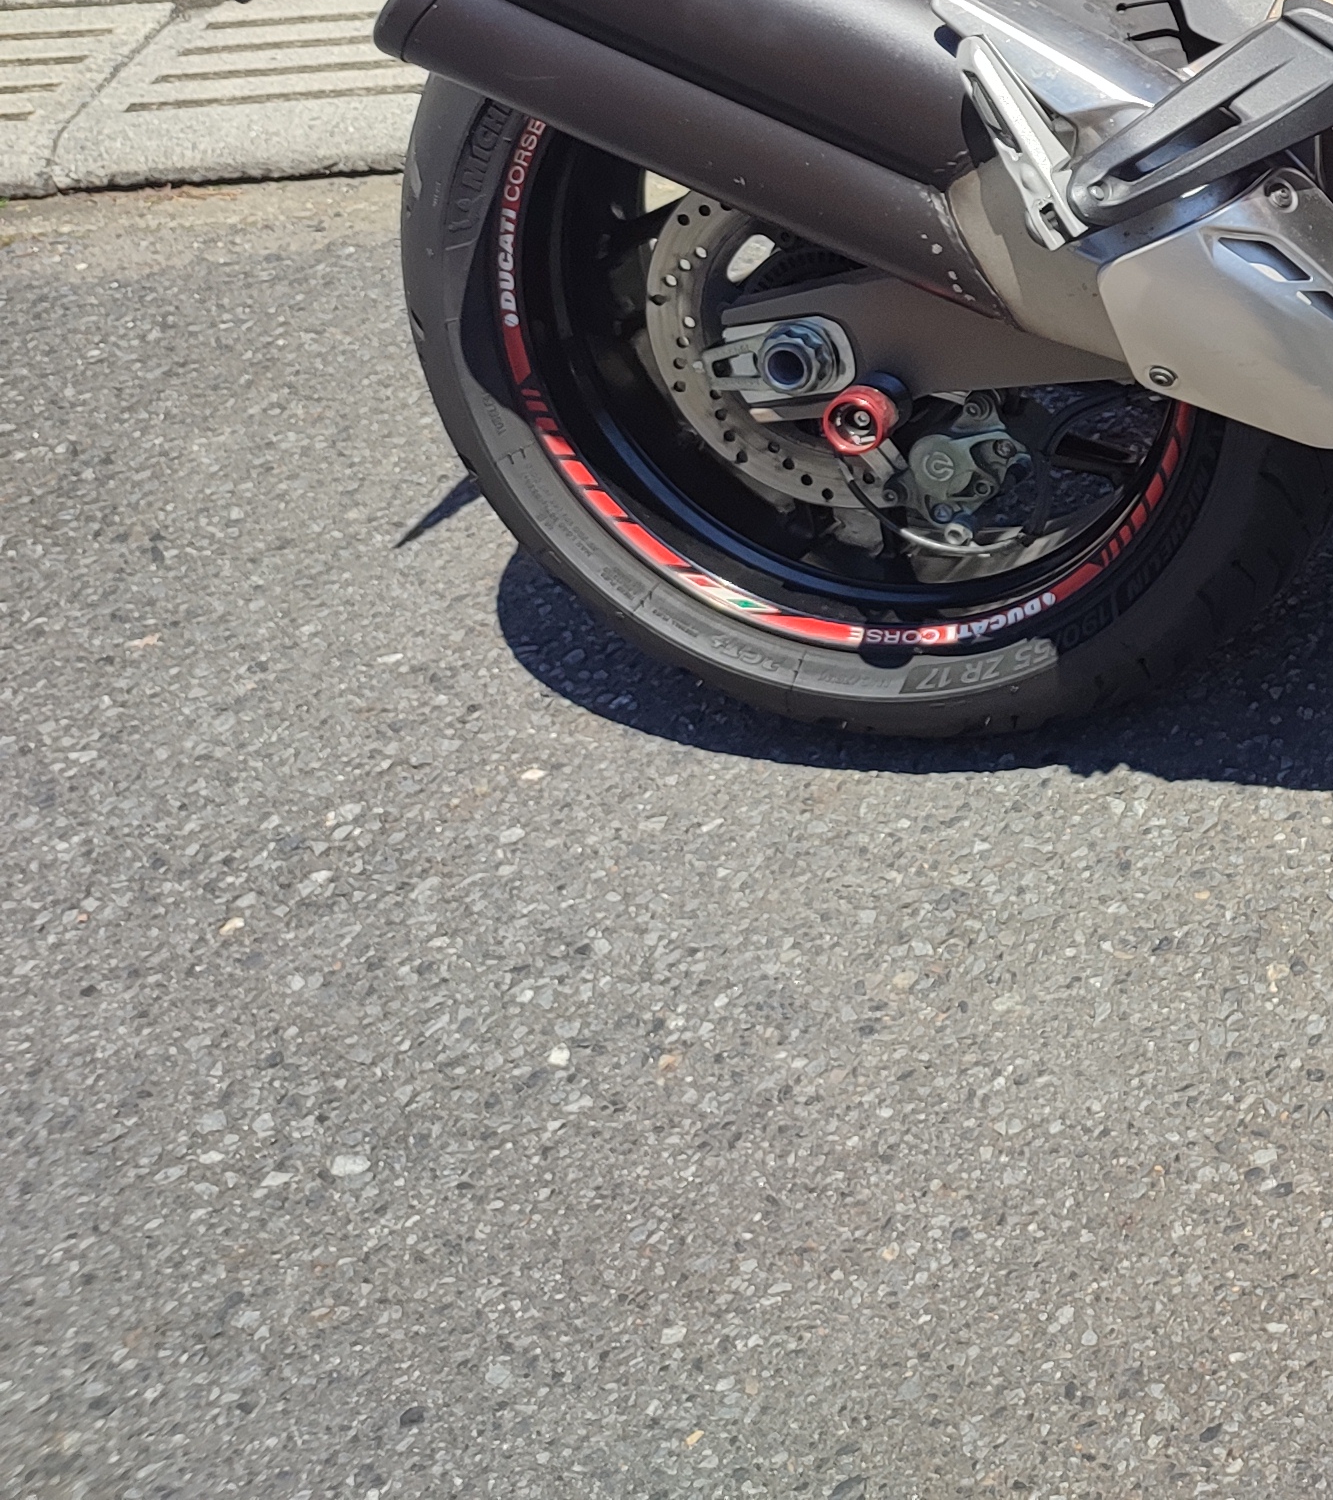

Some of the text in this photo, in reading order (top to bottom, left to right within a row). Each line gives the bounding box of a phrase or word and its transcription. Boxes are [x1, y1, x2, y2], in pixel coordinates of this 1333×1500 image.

[498, 118, 547, 312] DUCATI CORSE
[849, 596, 1043, 647] DUCATI CORSE
[915, 667, 951, 690] 17
[960, 656, 1007, 684] ZR
